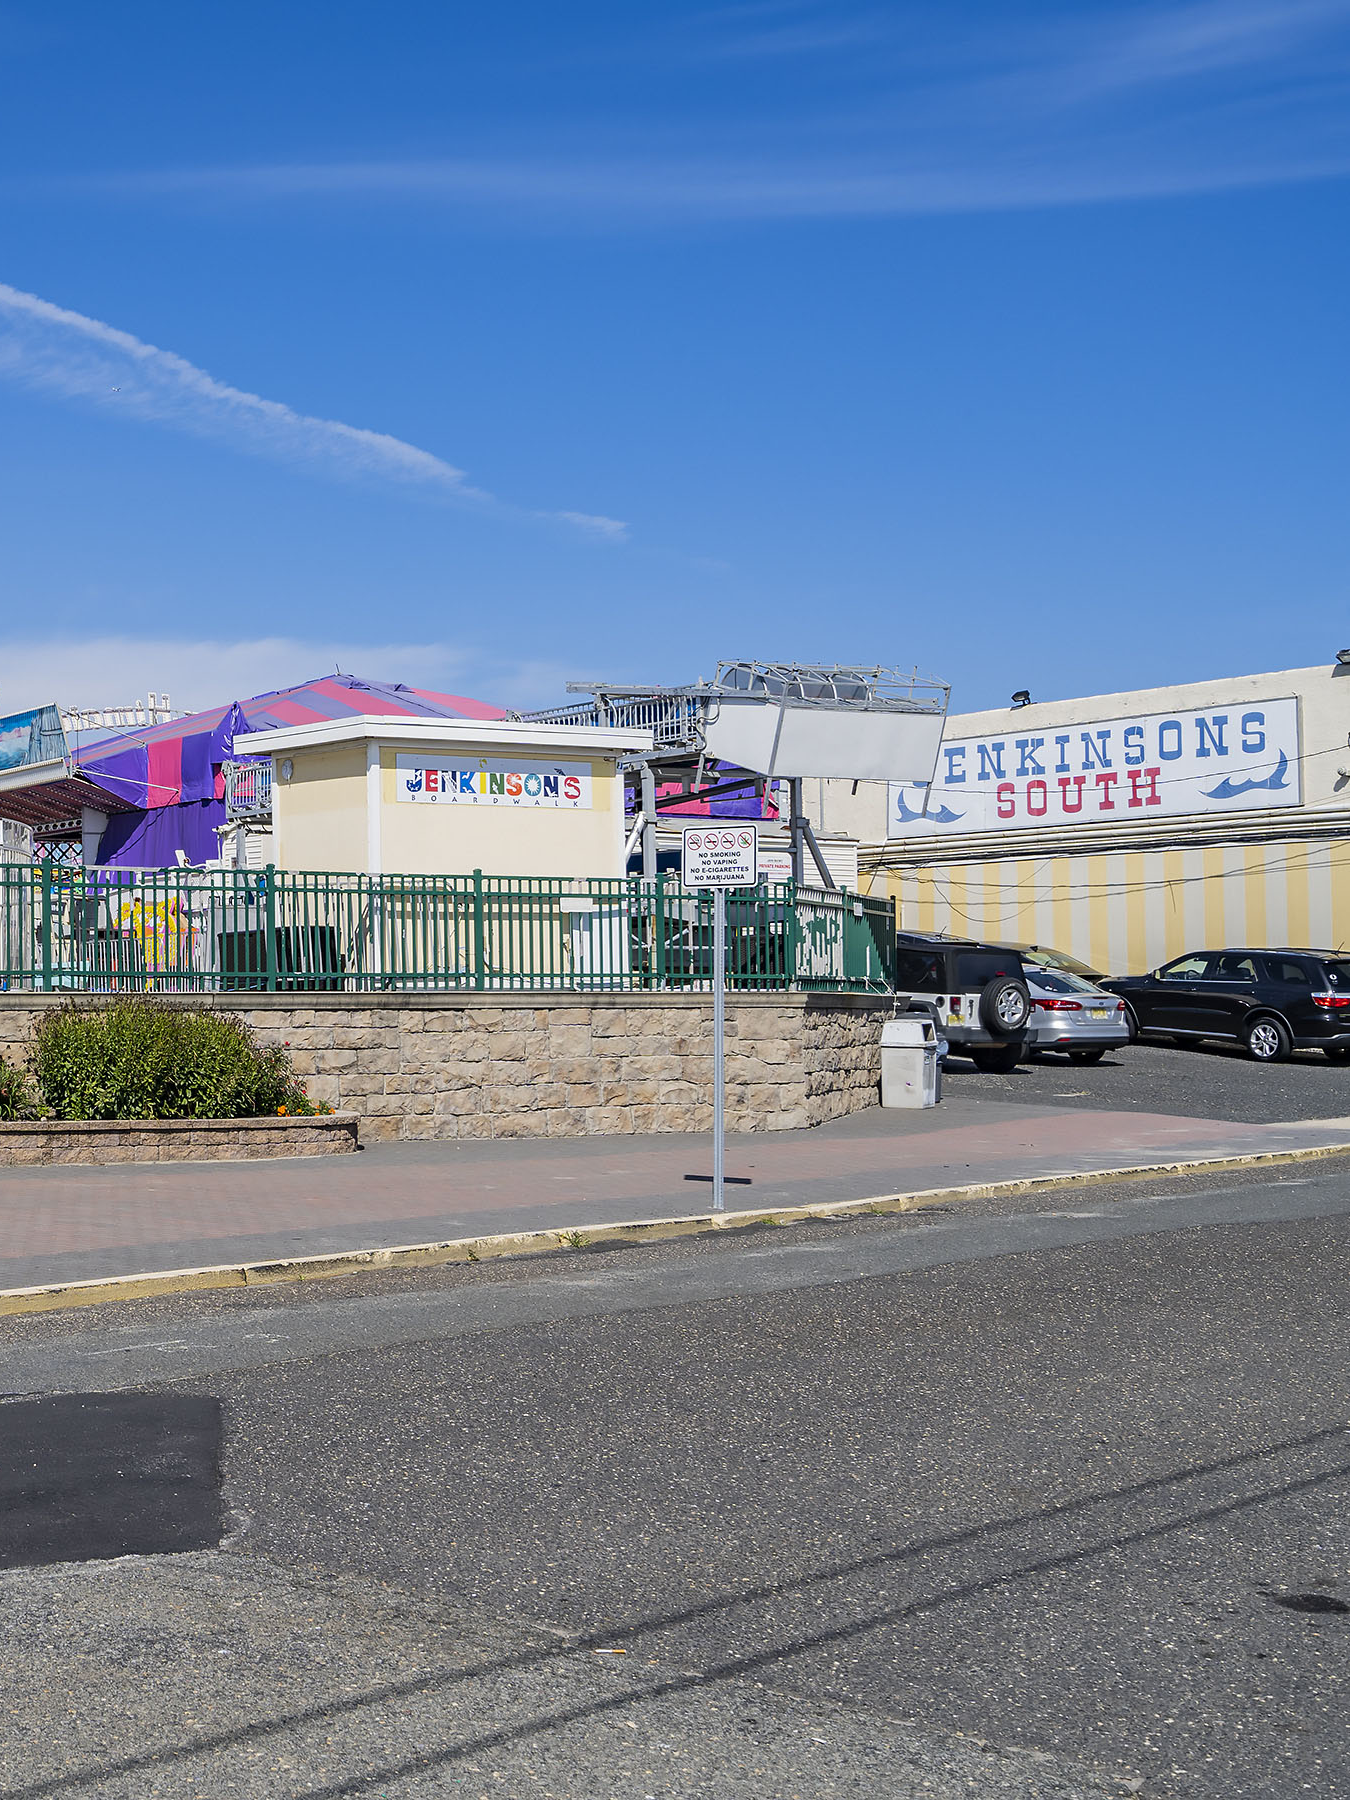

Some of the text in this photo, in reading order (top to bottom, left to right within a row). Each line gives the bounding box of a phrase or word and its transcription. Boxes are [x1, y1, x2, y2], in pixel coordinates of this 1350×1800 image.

[912, 711, 1266, 787] ENKINSONS
[411, 794, 578, 807] BOARDWALK
[997, 767, 1162, 819] SOUTH
